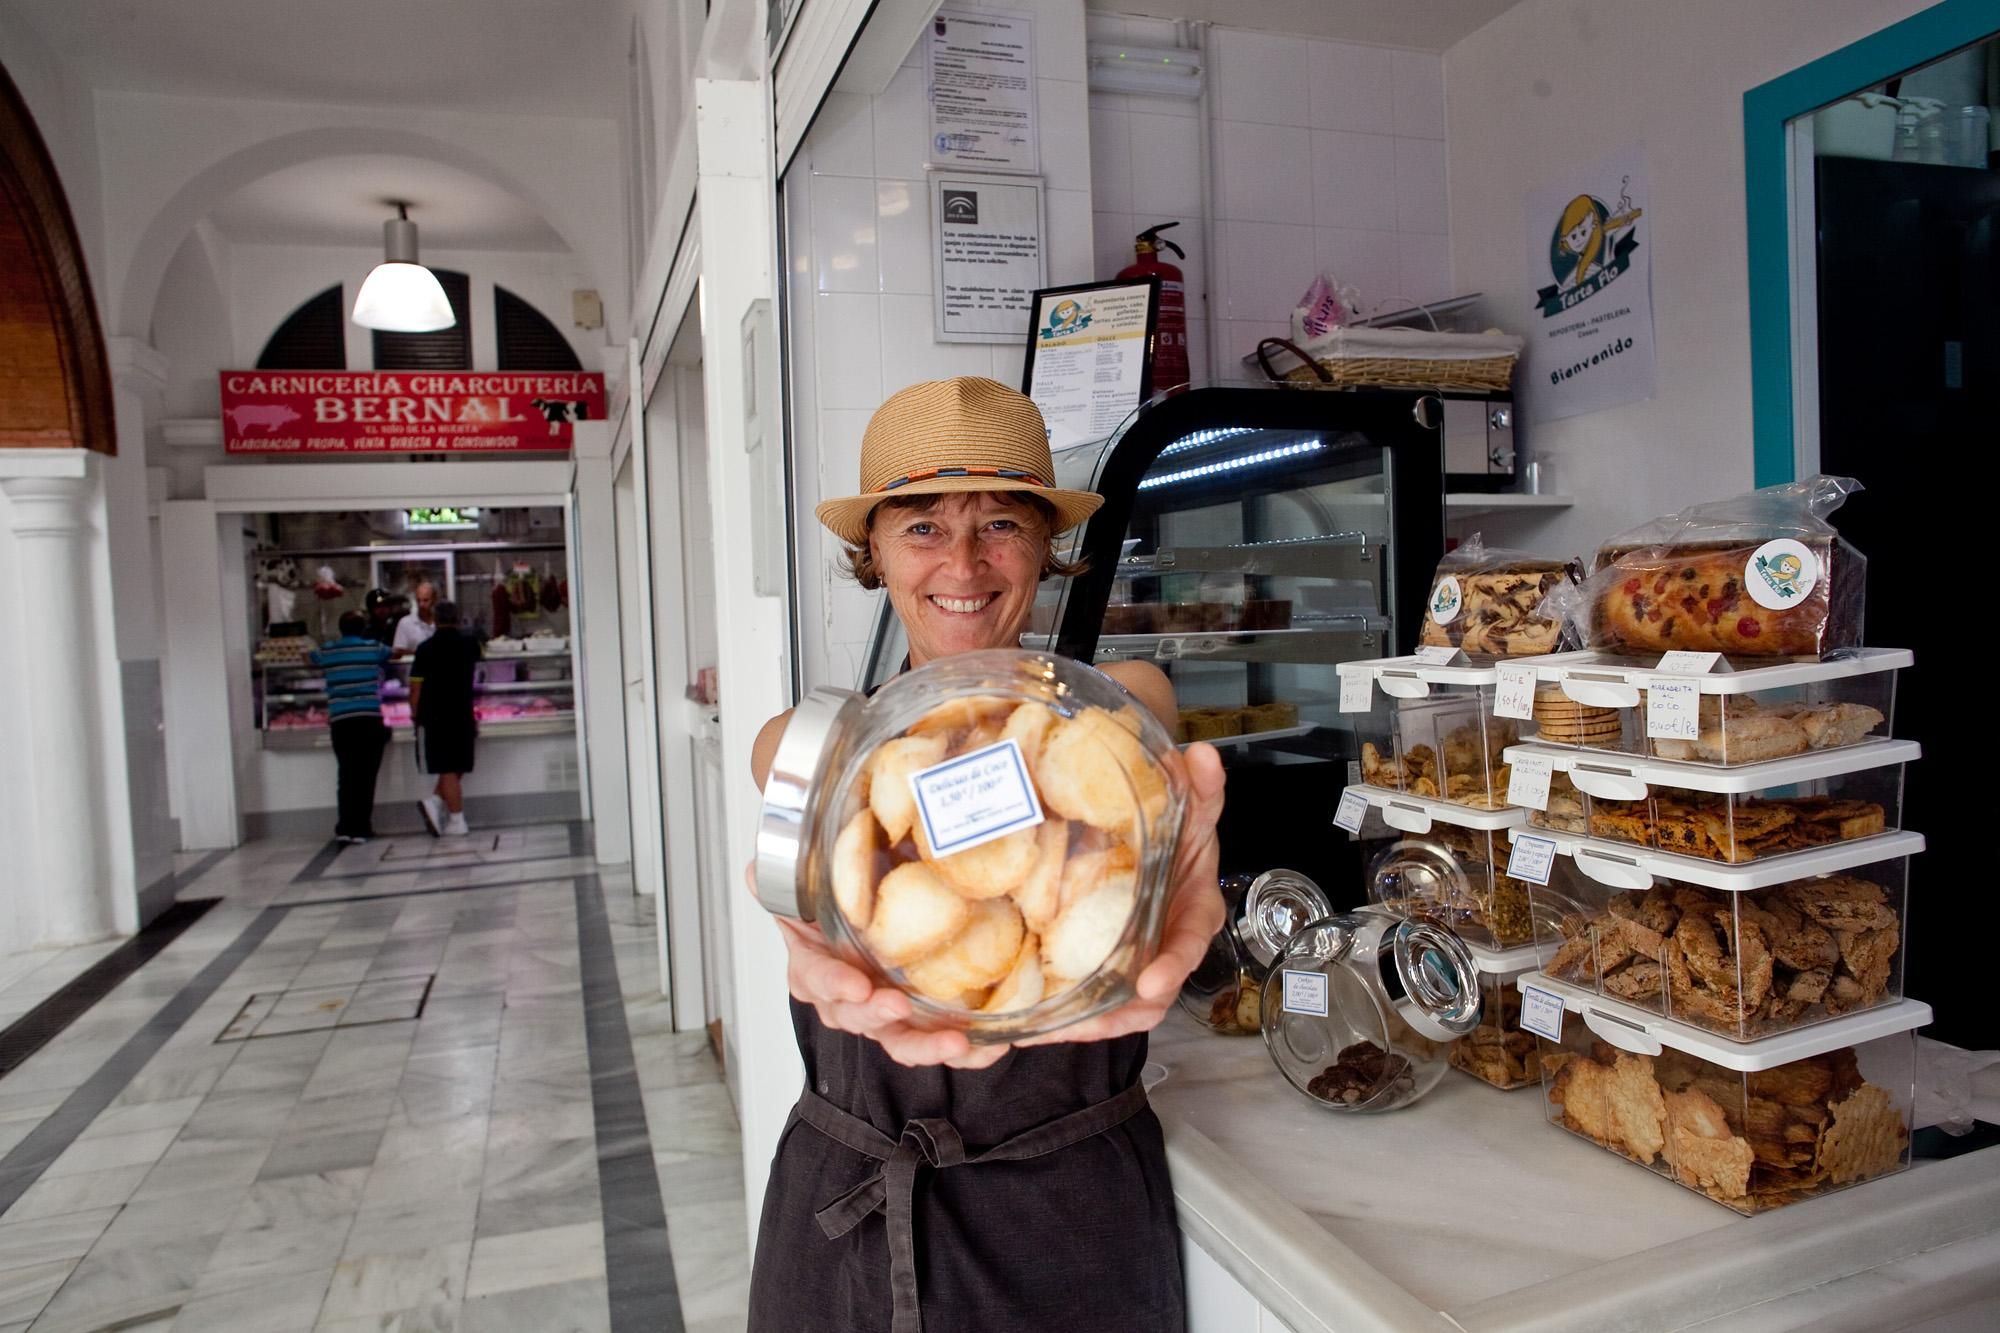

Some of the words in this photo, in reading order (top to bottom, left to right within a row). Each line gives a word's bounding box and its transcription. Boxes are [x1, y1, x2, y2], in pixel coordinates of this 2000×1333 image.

[1559, 283, 1595, 310] Tarta
[1599, 264, 1619, 288] Flo
[1550, 335, 1634, 385] Bienvenido
[227, 373, 404, 395] CARNICERÍA
[409, 372, 598, 395] CHARCUTERÍA
[314, 397, 528, 424] BERNAL
[406, 425, 419, 434] DE
[421, 425, 436, 434] LA
[229, 437, 301, 450] ELABORACIÓN
[354, 437, 385, 449] VENTA
[390, 436, 432, 449] DIRECTA
[435, 436, 448, 448] AL
[452, 436, 519, 448] CONSUMIDOR
